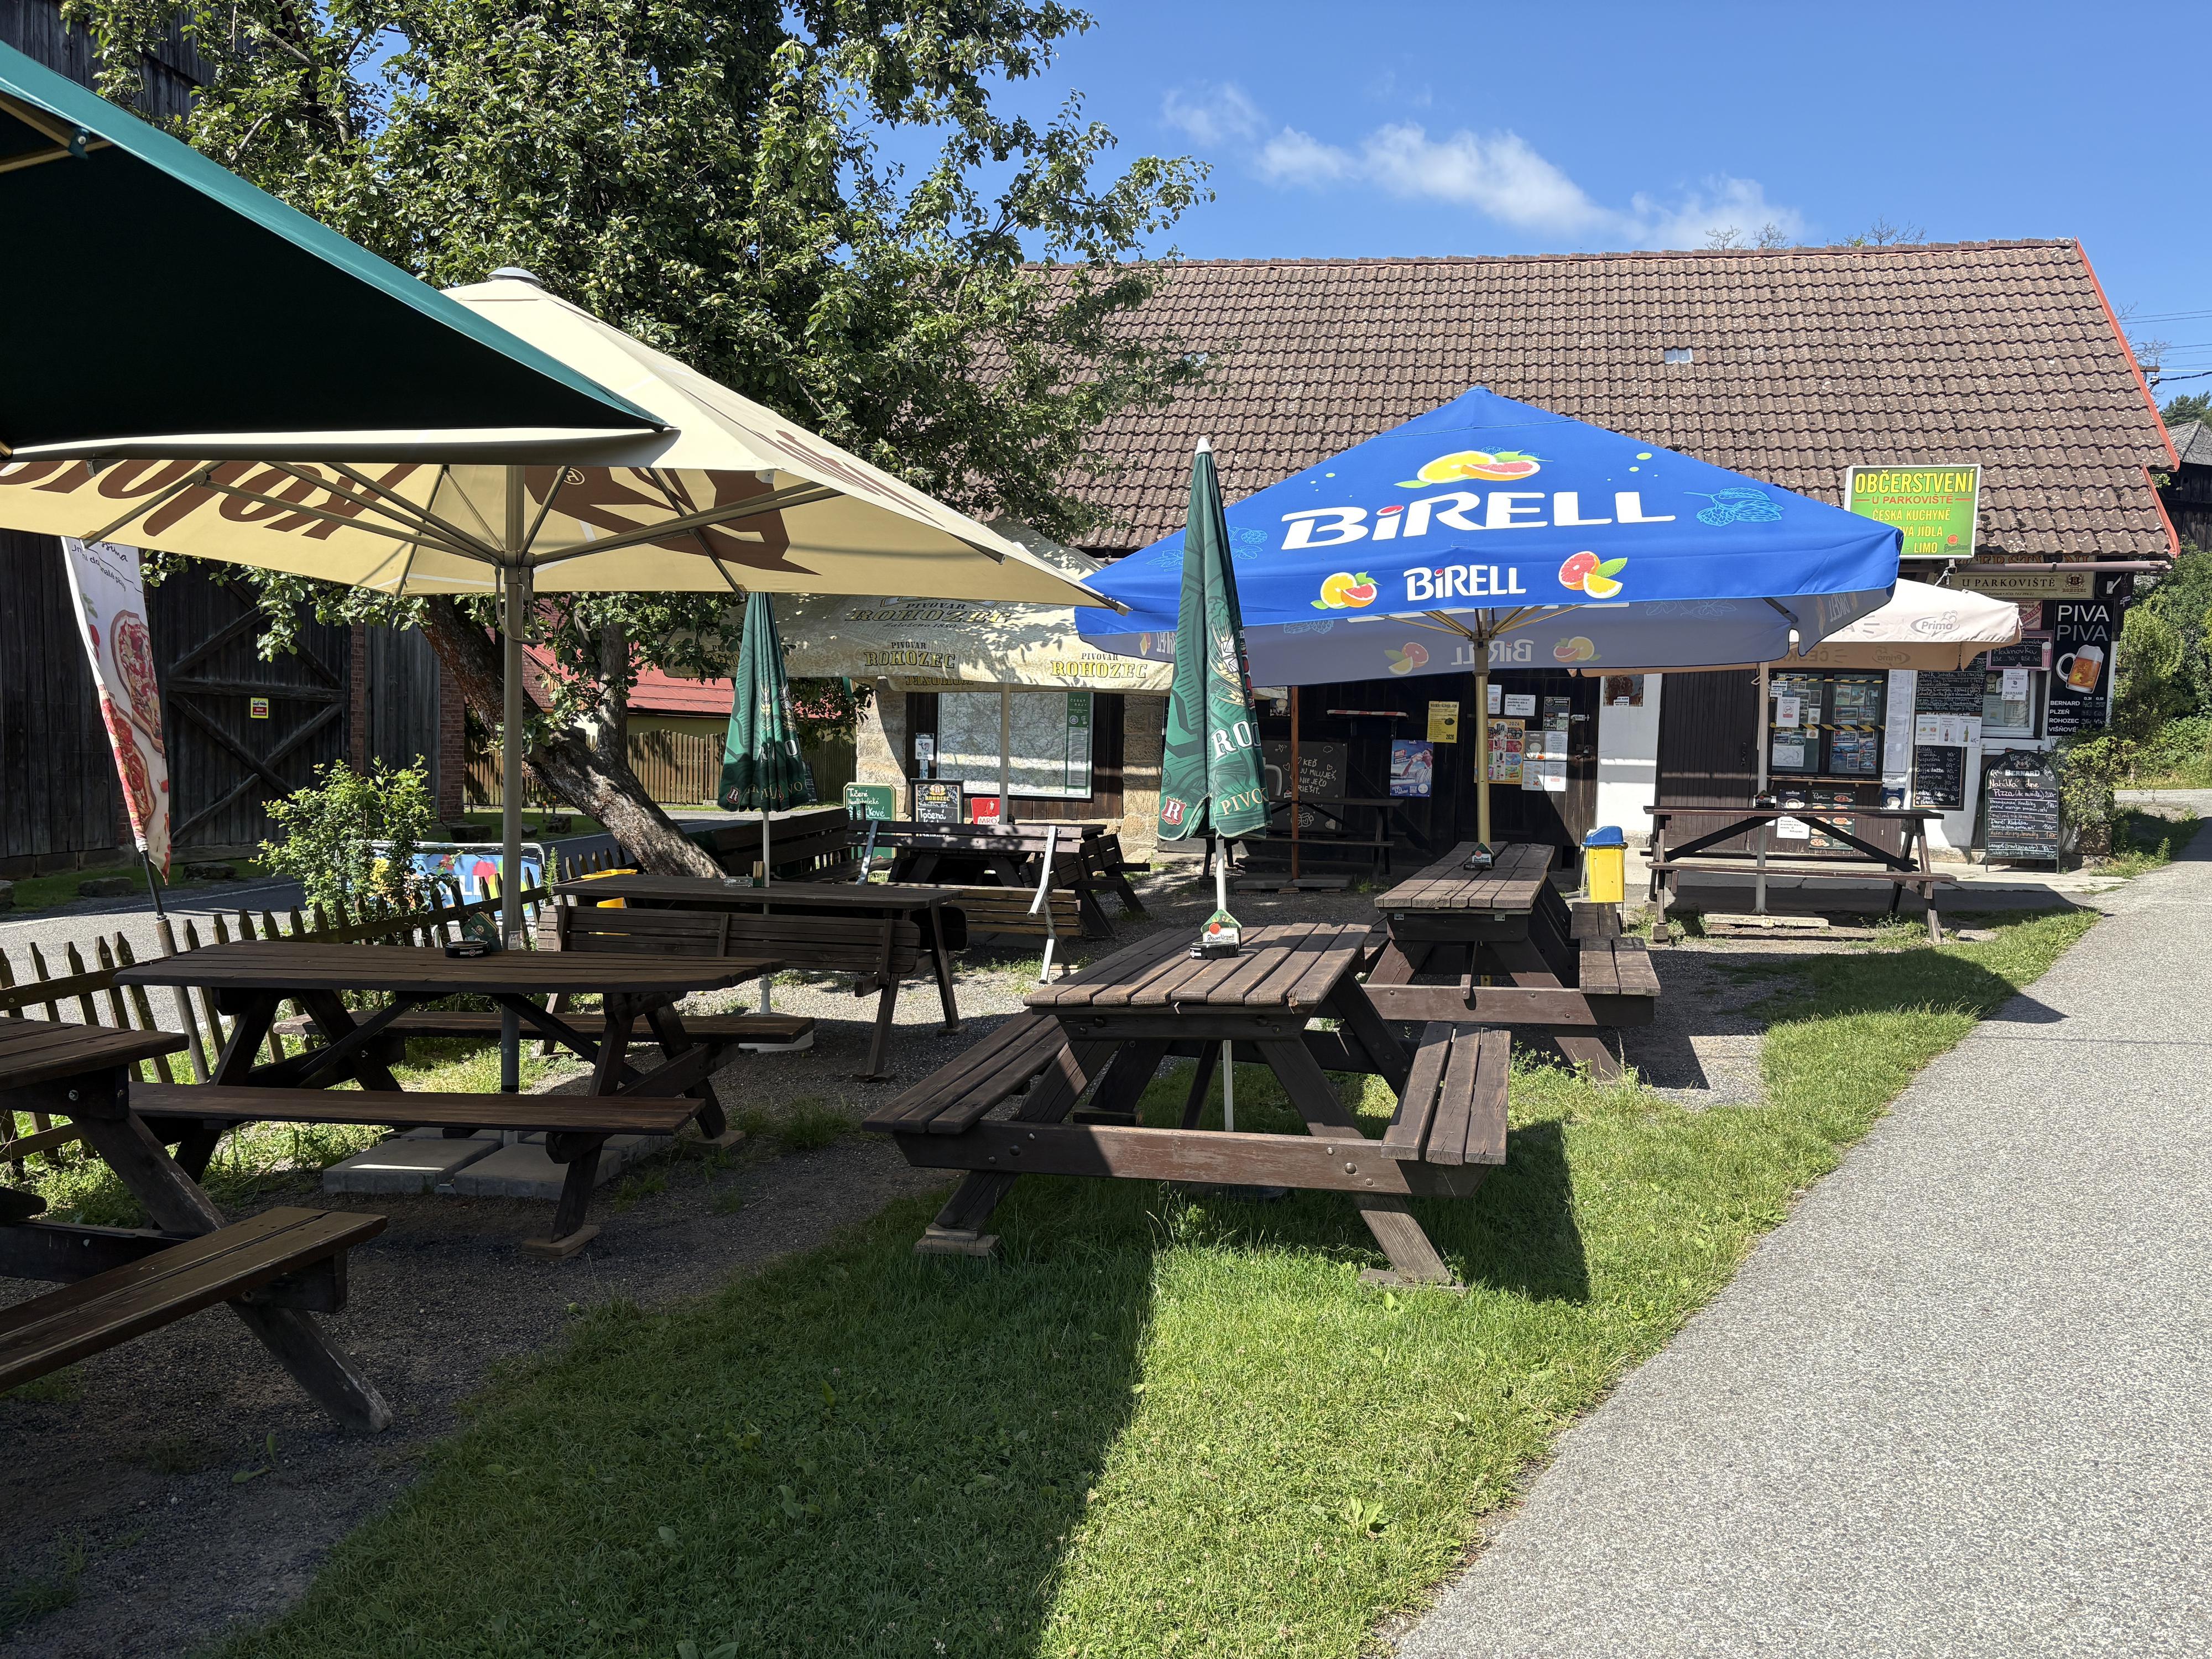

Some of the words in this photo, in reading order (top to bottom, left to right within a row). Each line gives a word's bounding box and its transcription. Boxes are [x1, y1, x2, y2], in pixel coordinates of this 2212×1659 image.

[1855, 468, 1975, 494] OBČERSTVENÍ
[1883, 494, 1953, 504] PARKOVIŠTĚ
[1872, 508, 1903, 521] ČESKÁ
[1906, 507, 1950, 521] KUCHYNĚ
[1917, 524, 1943, 537] JÍDLA
[1914, 542, 1938, 553] LIMO
[1975, 577, 2056, 587] PARKOVIŠTĚ
[845, 609, 1012, 623] ROHOZEC
[2058, 605, 2110, 622] PIVA
[1922, 621, 1952, 630] Prima
[2057, 625, 2109, 641] PIVA
[864, 650, 956, 668] ROHOZEC
[1051, 660, 1147, 678] ROHOZEC
[1303, 758, 1317, 767] KEĎ
[918, 808, 946, 820] Točená
